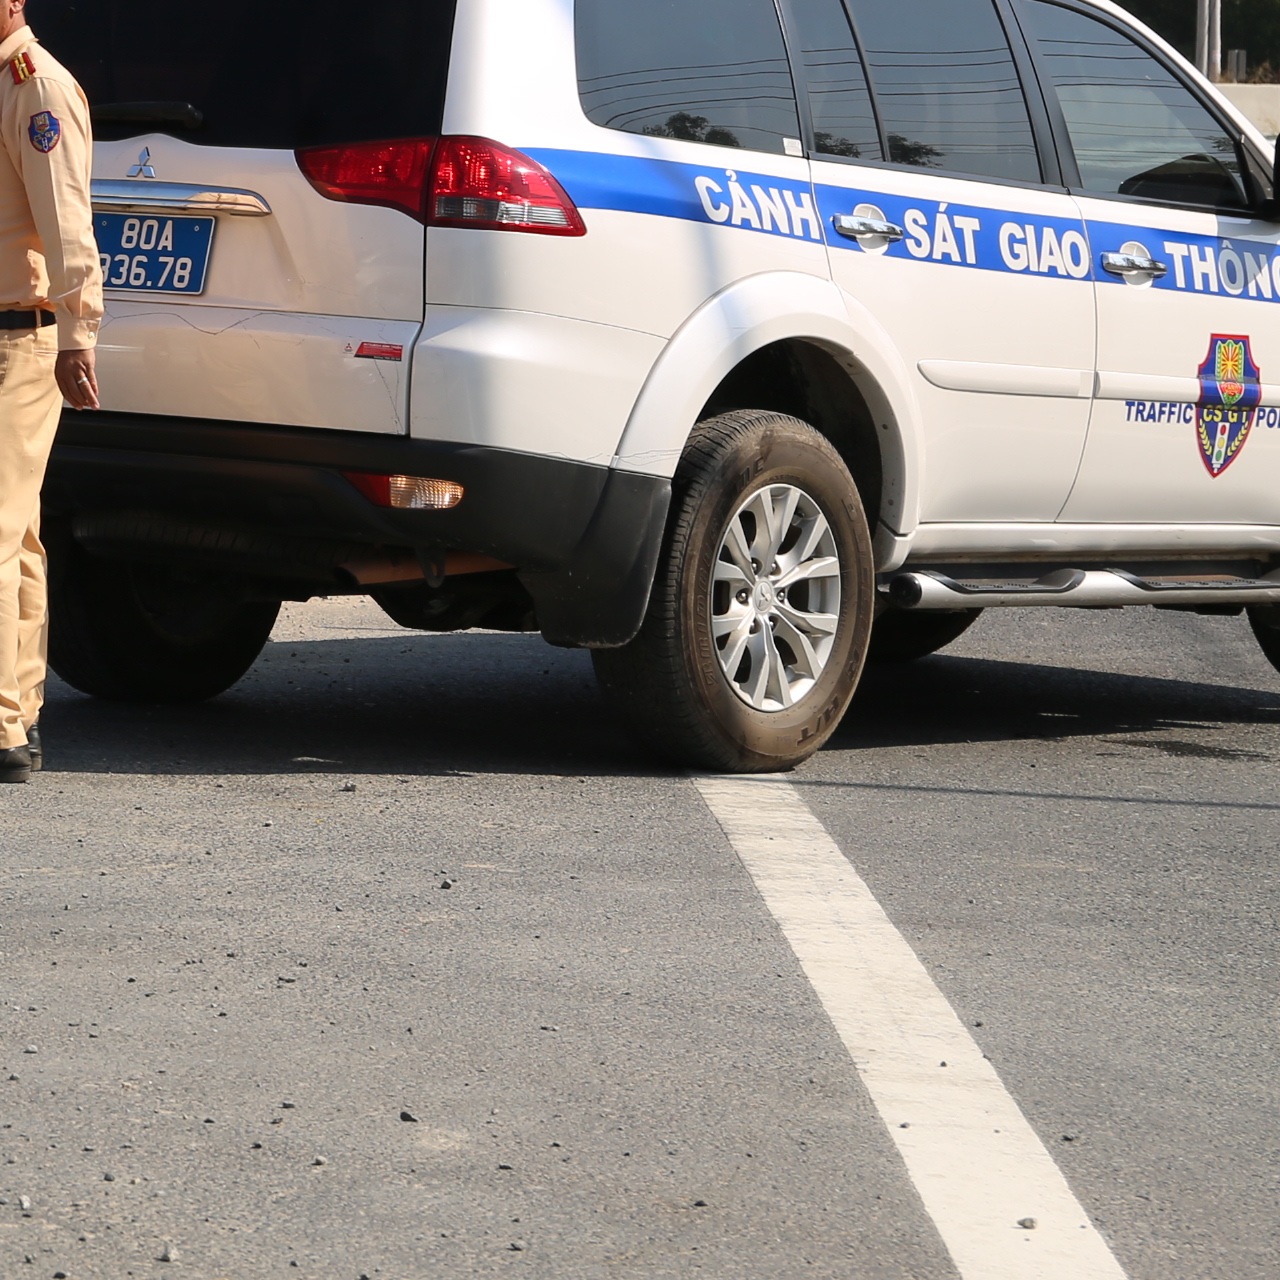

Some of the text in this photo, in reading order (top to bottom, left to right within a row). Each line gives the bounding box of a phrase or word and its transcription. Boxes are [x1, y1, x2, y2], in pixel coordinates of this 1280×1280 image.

[121, 218, 173, 251] 80A
[694, 170, 821, 240] CẢNH
[904, 202, 981, 265] SÁT
[999, 221, 1090, 279] GIAO
[1125, 400, 1193, 424] TRAFFIC
